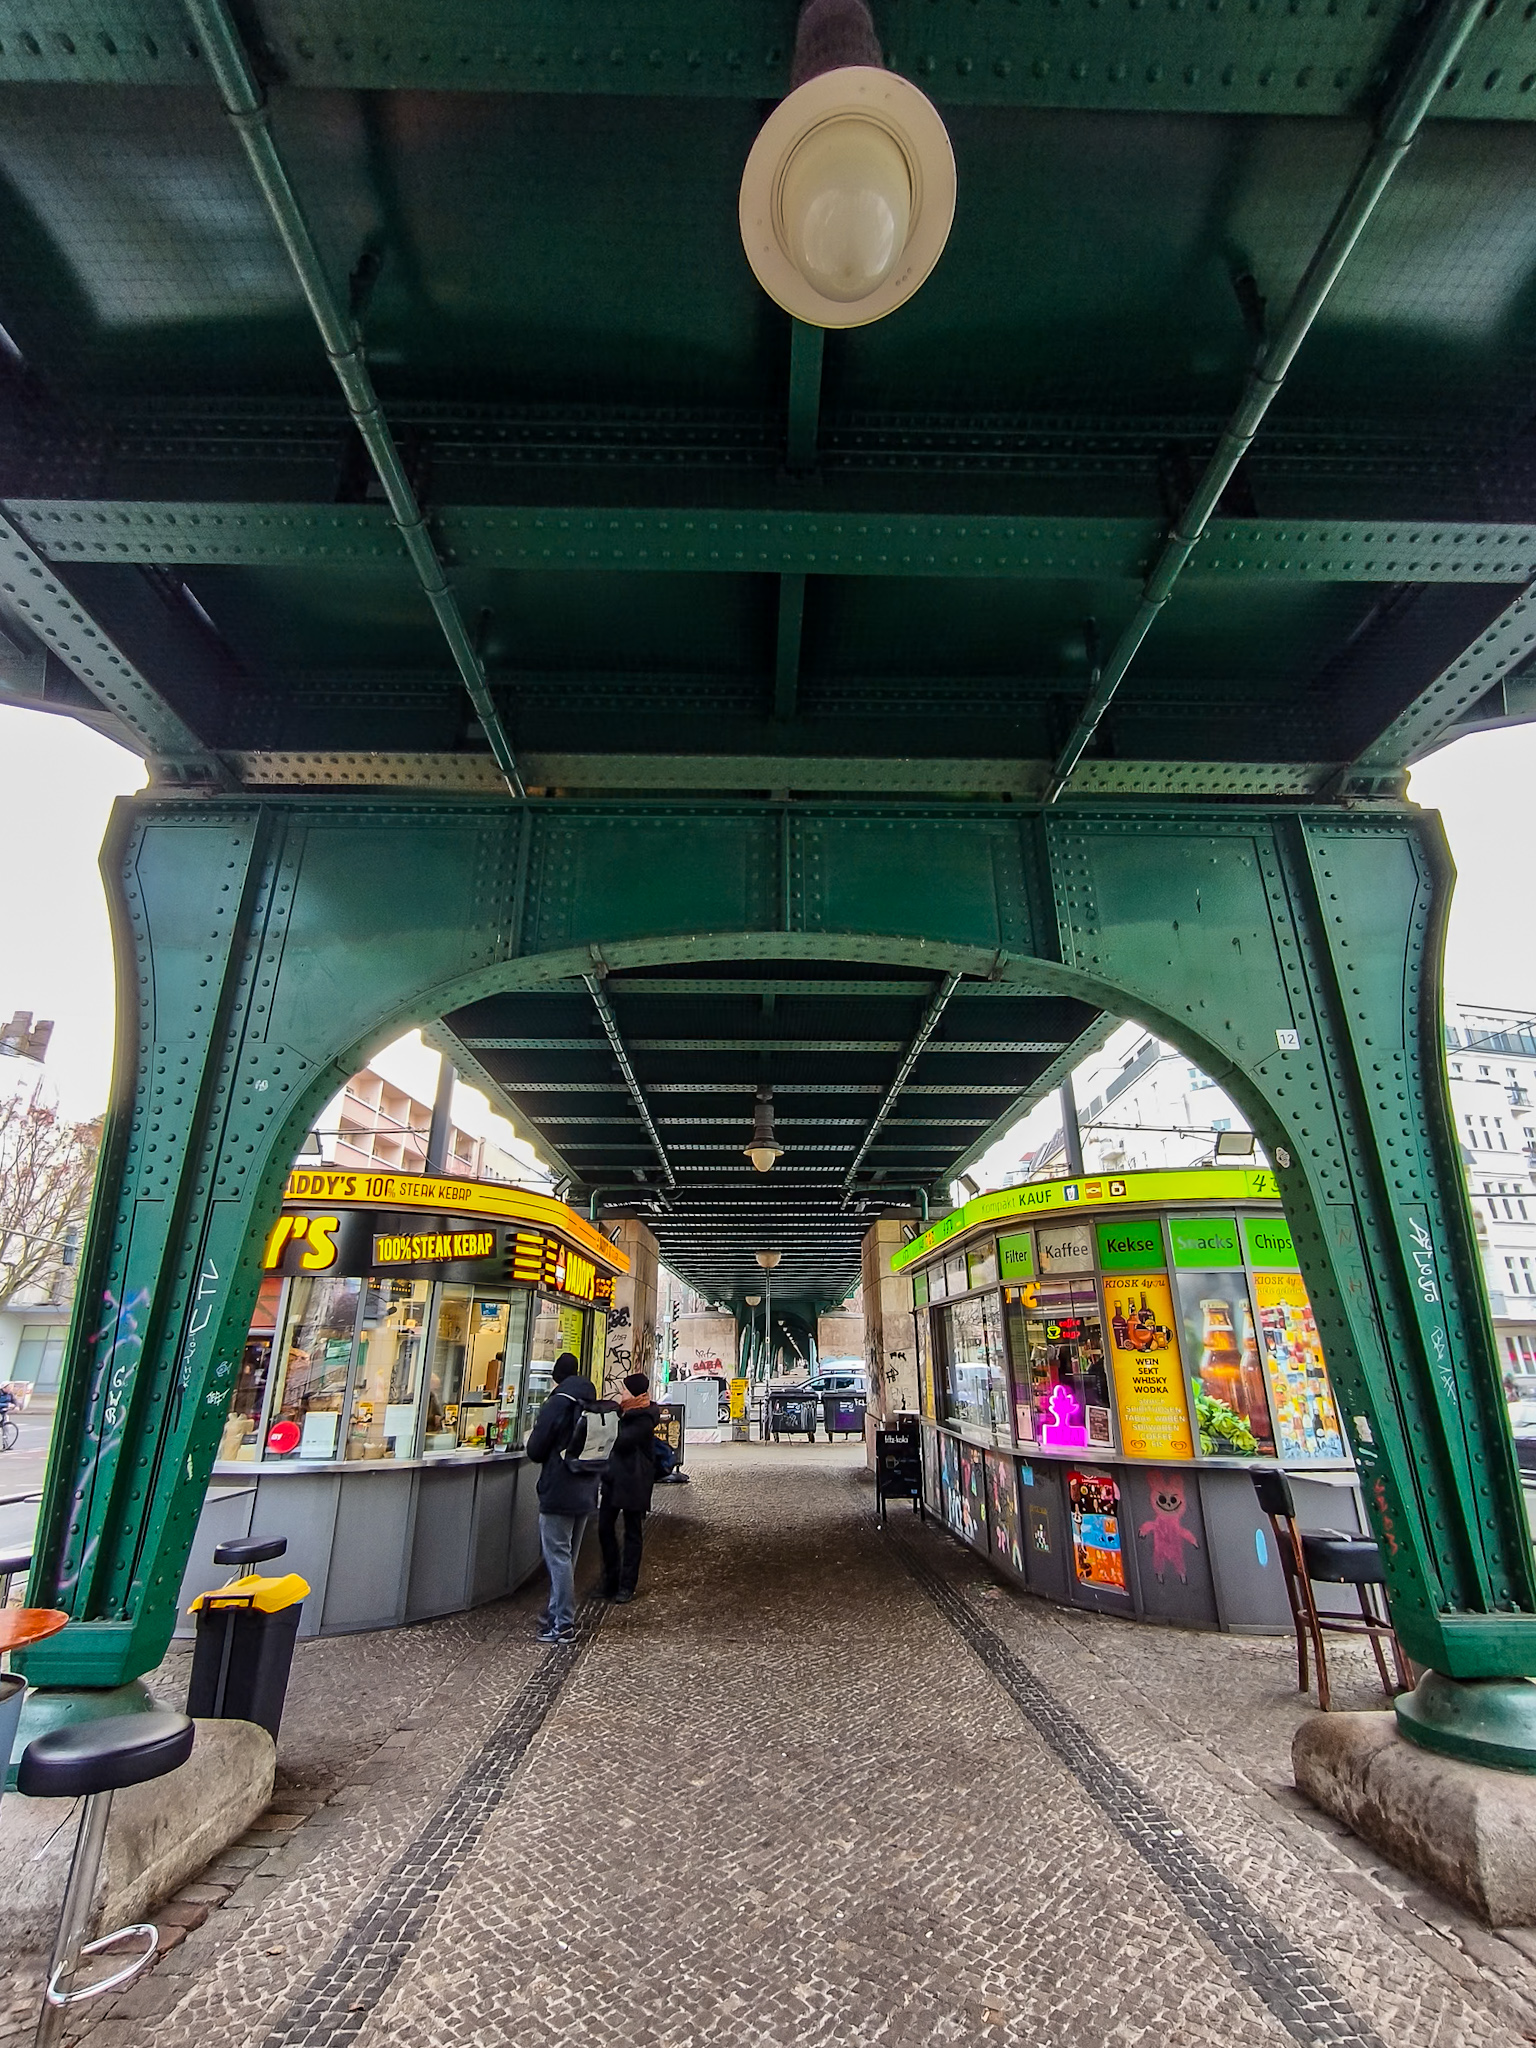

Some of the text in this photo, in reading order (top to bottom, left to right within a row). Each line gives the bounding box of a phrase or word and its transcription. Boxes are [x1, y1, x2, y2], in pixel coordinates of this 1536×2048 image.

[1280, 1034, 1296, 1045] 12
[400, 1182, 436, 1198] STEAK
[438, 1186, 472, 1201] KEBAP
[1018, 1189, 1053, 1207] KAUF
[378, 1232, 494, 1262] 100% STEAK KEBAP
[1045, 1242, 1089, 1260] Kaffee
[1106, 1238, 1154, 1253] Kekse
[1254, 1233, 1293, 1254] Chips
[1005, 1250, 1028, 1265] Filter
[1105, 1279, 1139, 1289] KIOSK
[1254, 1276, 1284, 1286] KIOSK
[1135, 1358, 1159, 1366] WEIN
[1138, 1367, 1159, 1375] SEKT
[1134, 1386, 1169, 1394] WODKA
